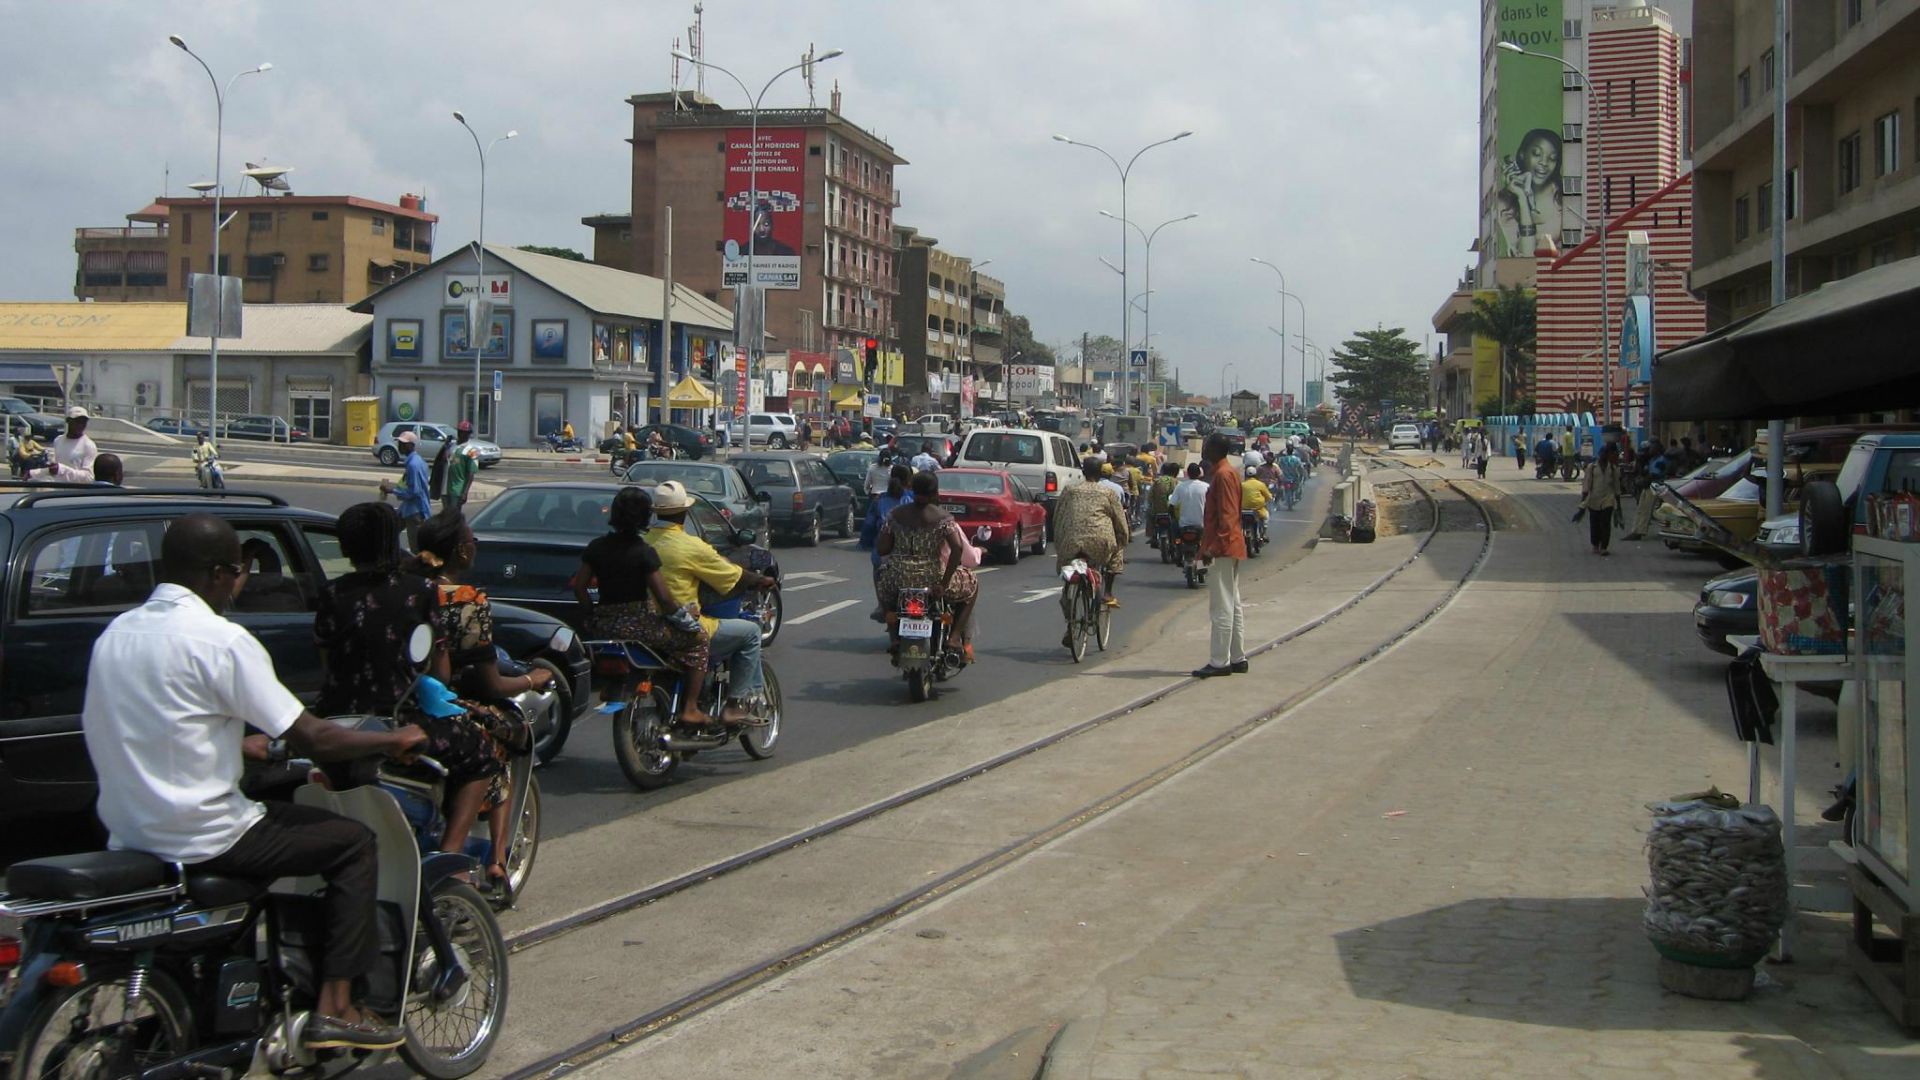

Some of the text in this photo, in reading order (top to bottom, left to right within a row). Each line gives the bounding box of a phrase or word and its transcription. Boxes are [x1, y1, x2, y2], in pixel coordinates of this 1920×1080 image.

[1501, 2, 1548, 21] dans le
[116, 917, 172, 942] YAMAHA
